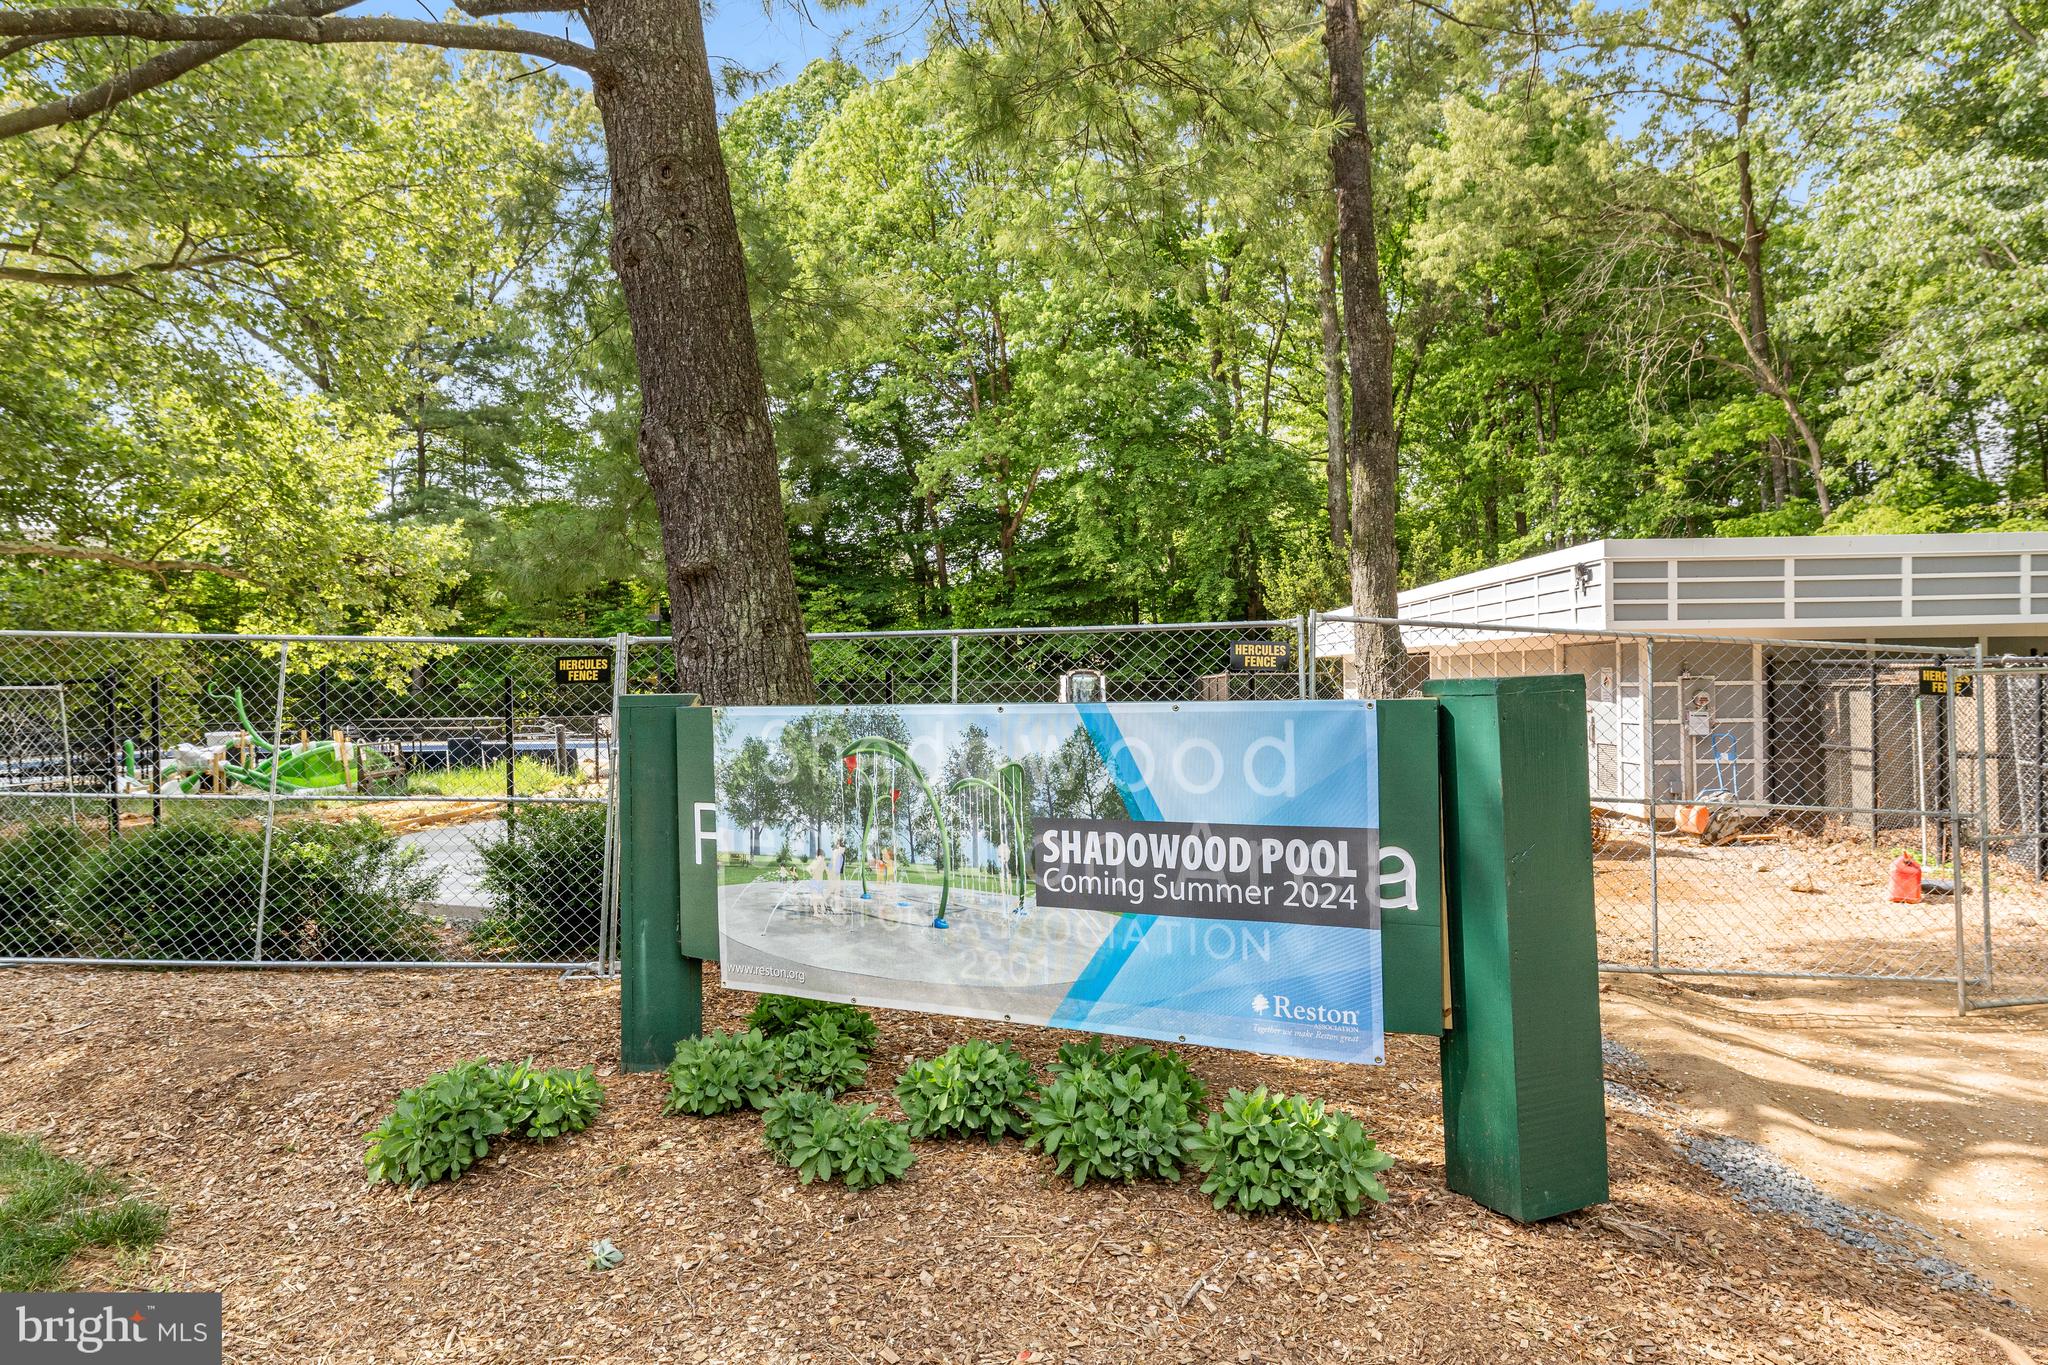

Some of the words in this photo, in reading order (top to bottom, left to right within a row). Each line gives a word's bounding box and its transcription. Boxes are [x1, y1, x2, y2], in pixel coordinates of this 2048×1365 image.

[1235, 644, 1287, 656] HERCULES
[559, 659, 608, 670] HERCULES
[1244, 656, 1277, 668] FENCE
[568, 670, 599, 681] FENCE
[1922, 670, 1970, 683] HERCLES
[1042, 829, 1251, 874] SHADOWOOD
[1261, 838, 1357, 878] POOL
[1043, 867, 1145, 905] Coming
[1153, 873, 1274, 904] Summer
[1283, 880, 1358, 911] 2024
[727, 964, 806, 984] www.reston.org
[1273, 995, 1359, 1026] Reston
[1313, 1023, 1360, 1033] ASSOCIATION
[1294, 1029, 1313, 1038] make
[1316, 1030, 1338, 1040] Reston
[1339, 1034, 1360, 1044] great
